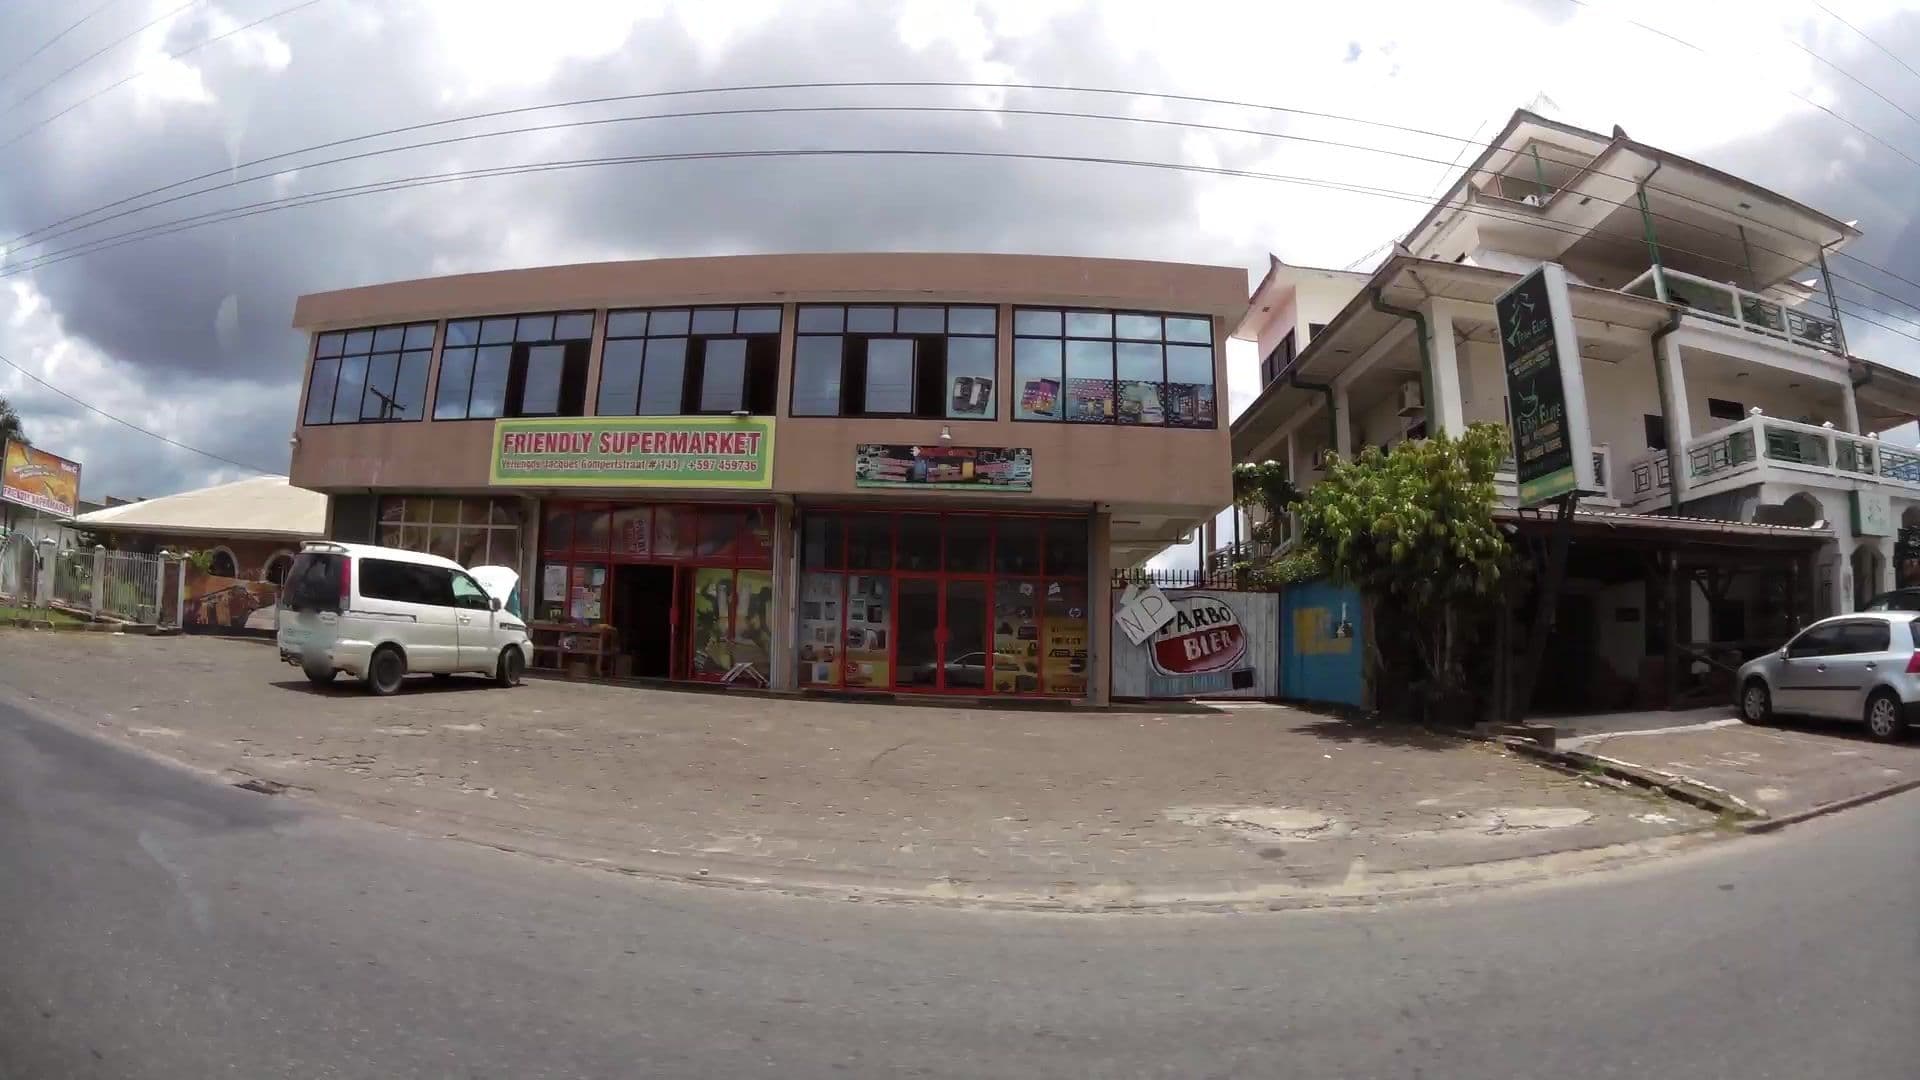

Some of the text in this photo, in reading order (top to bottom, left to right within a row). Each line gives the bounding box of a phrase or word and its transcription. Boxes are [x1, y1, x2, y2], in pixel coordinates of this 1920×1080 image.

[503, 431, 761, 455] FRIENDLY SUPERMARKET
[718, 460, 757, 471] 459736
[1183, 630, 1233, 661] BIER
